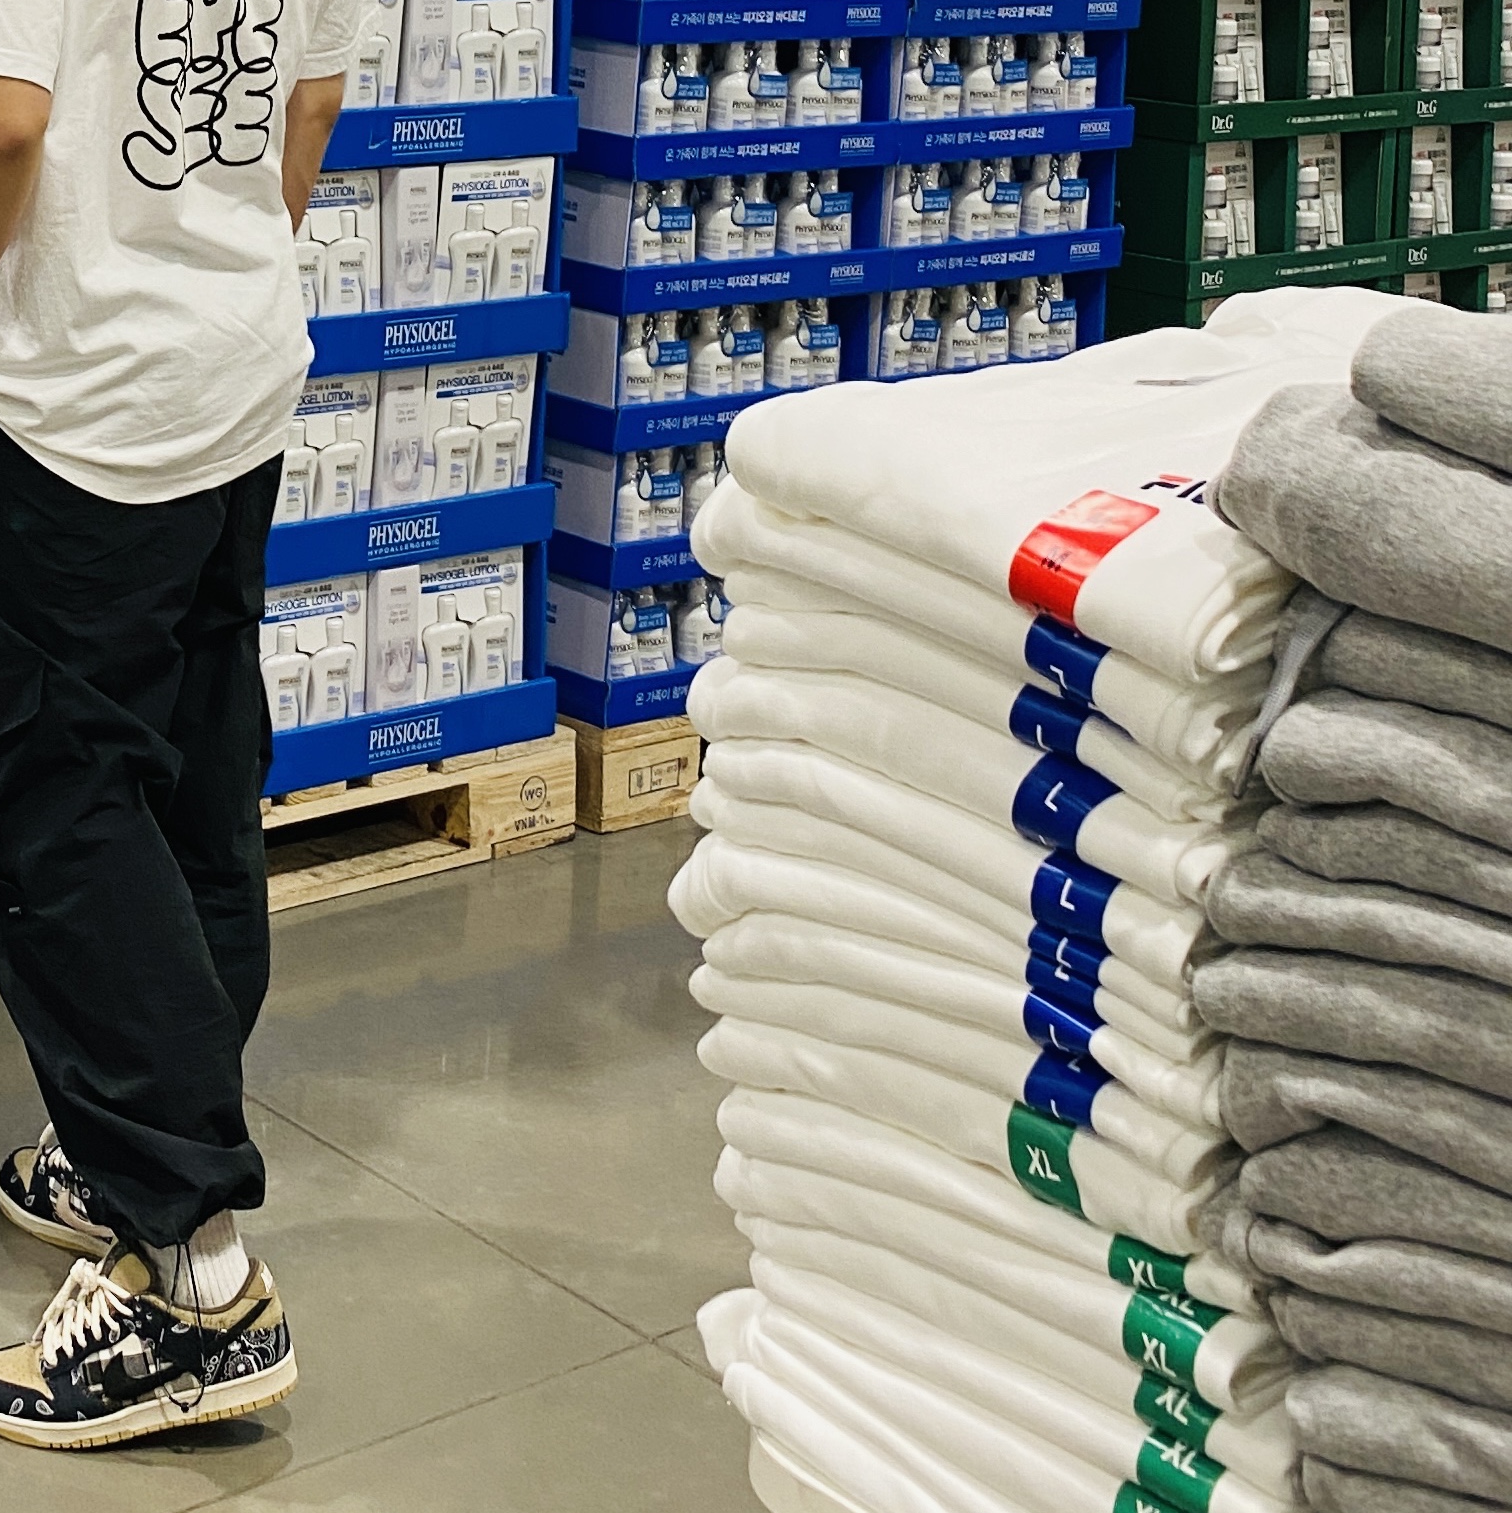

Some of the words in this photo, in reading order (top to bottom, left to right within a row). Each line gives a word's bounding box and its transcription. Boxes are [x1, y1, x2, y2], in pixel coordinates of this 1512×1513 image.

[742, 11, 775, 24] 피지오겔
[846, 7, 881, 20] PHYSIOGEL
[1416, 100, 1437, 114] Dr.G
[122, 55, 278, 191] SEE
[392, 118, 465, 141] PHYSIOGEL
[1211, 115, 1234, 130] Dr.G
[451, 181, 497, 193] PHYSIOGEL
[499, 178, 529, 190] LOTION
[1408, 246, 1428, 262] Dr.G
[1201, 270, 1224, 286] Dr.G
[384, 320, 457, 347] PHYSIOGEL
[436, 375, 483, 390] PHYSIOGEL
[484, 372, 514, 386] LOTION
[368, 516, 441, 548] PHYSIOGEL
[420, 568, 467, 584] PHYSIOGEL
[468, 564, 500, 579] LOTION
[369, 717, 443, 750] PHYSIOGEL
[524, 787, 543, 801] WG
[1044, 781, 1064, 813] L
[1060, 878, 1076, 911] L
[1026, 1143, 1062, 1183] XL
[1127, 1256, 1168, 1291] XL
[1141, 1331, 1177, 1378] XL
[1155, 1386, 1189, 1426] XL
[1160, 1440, 1197, 1478] XL
